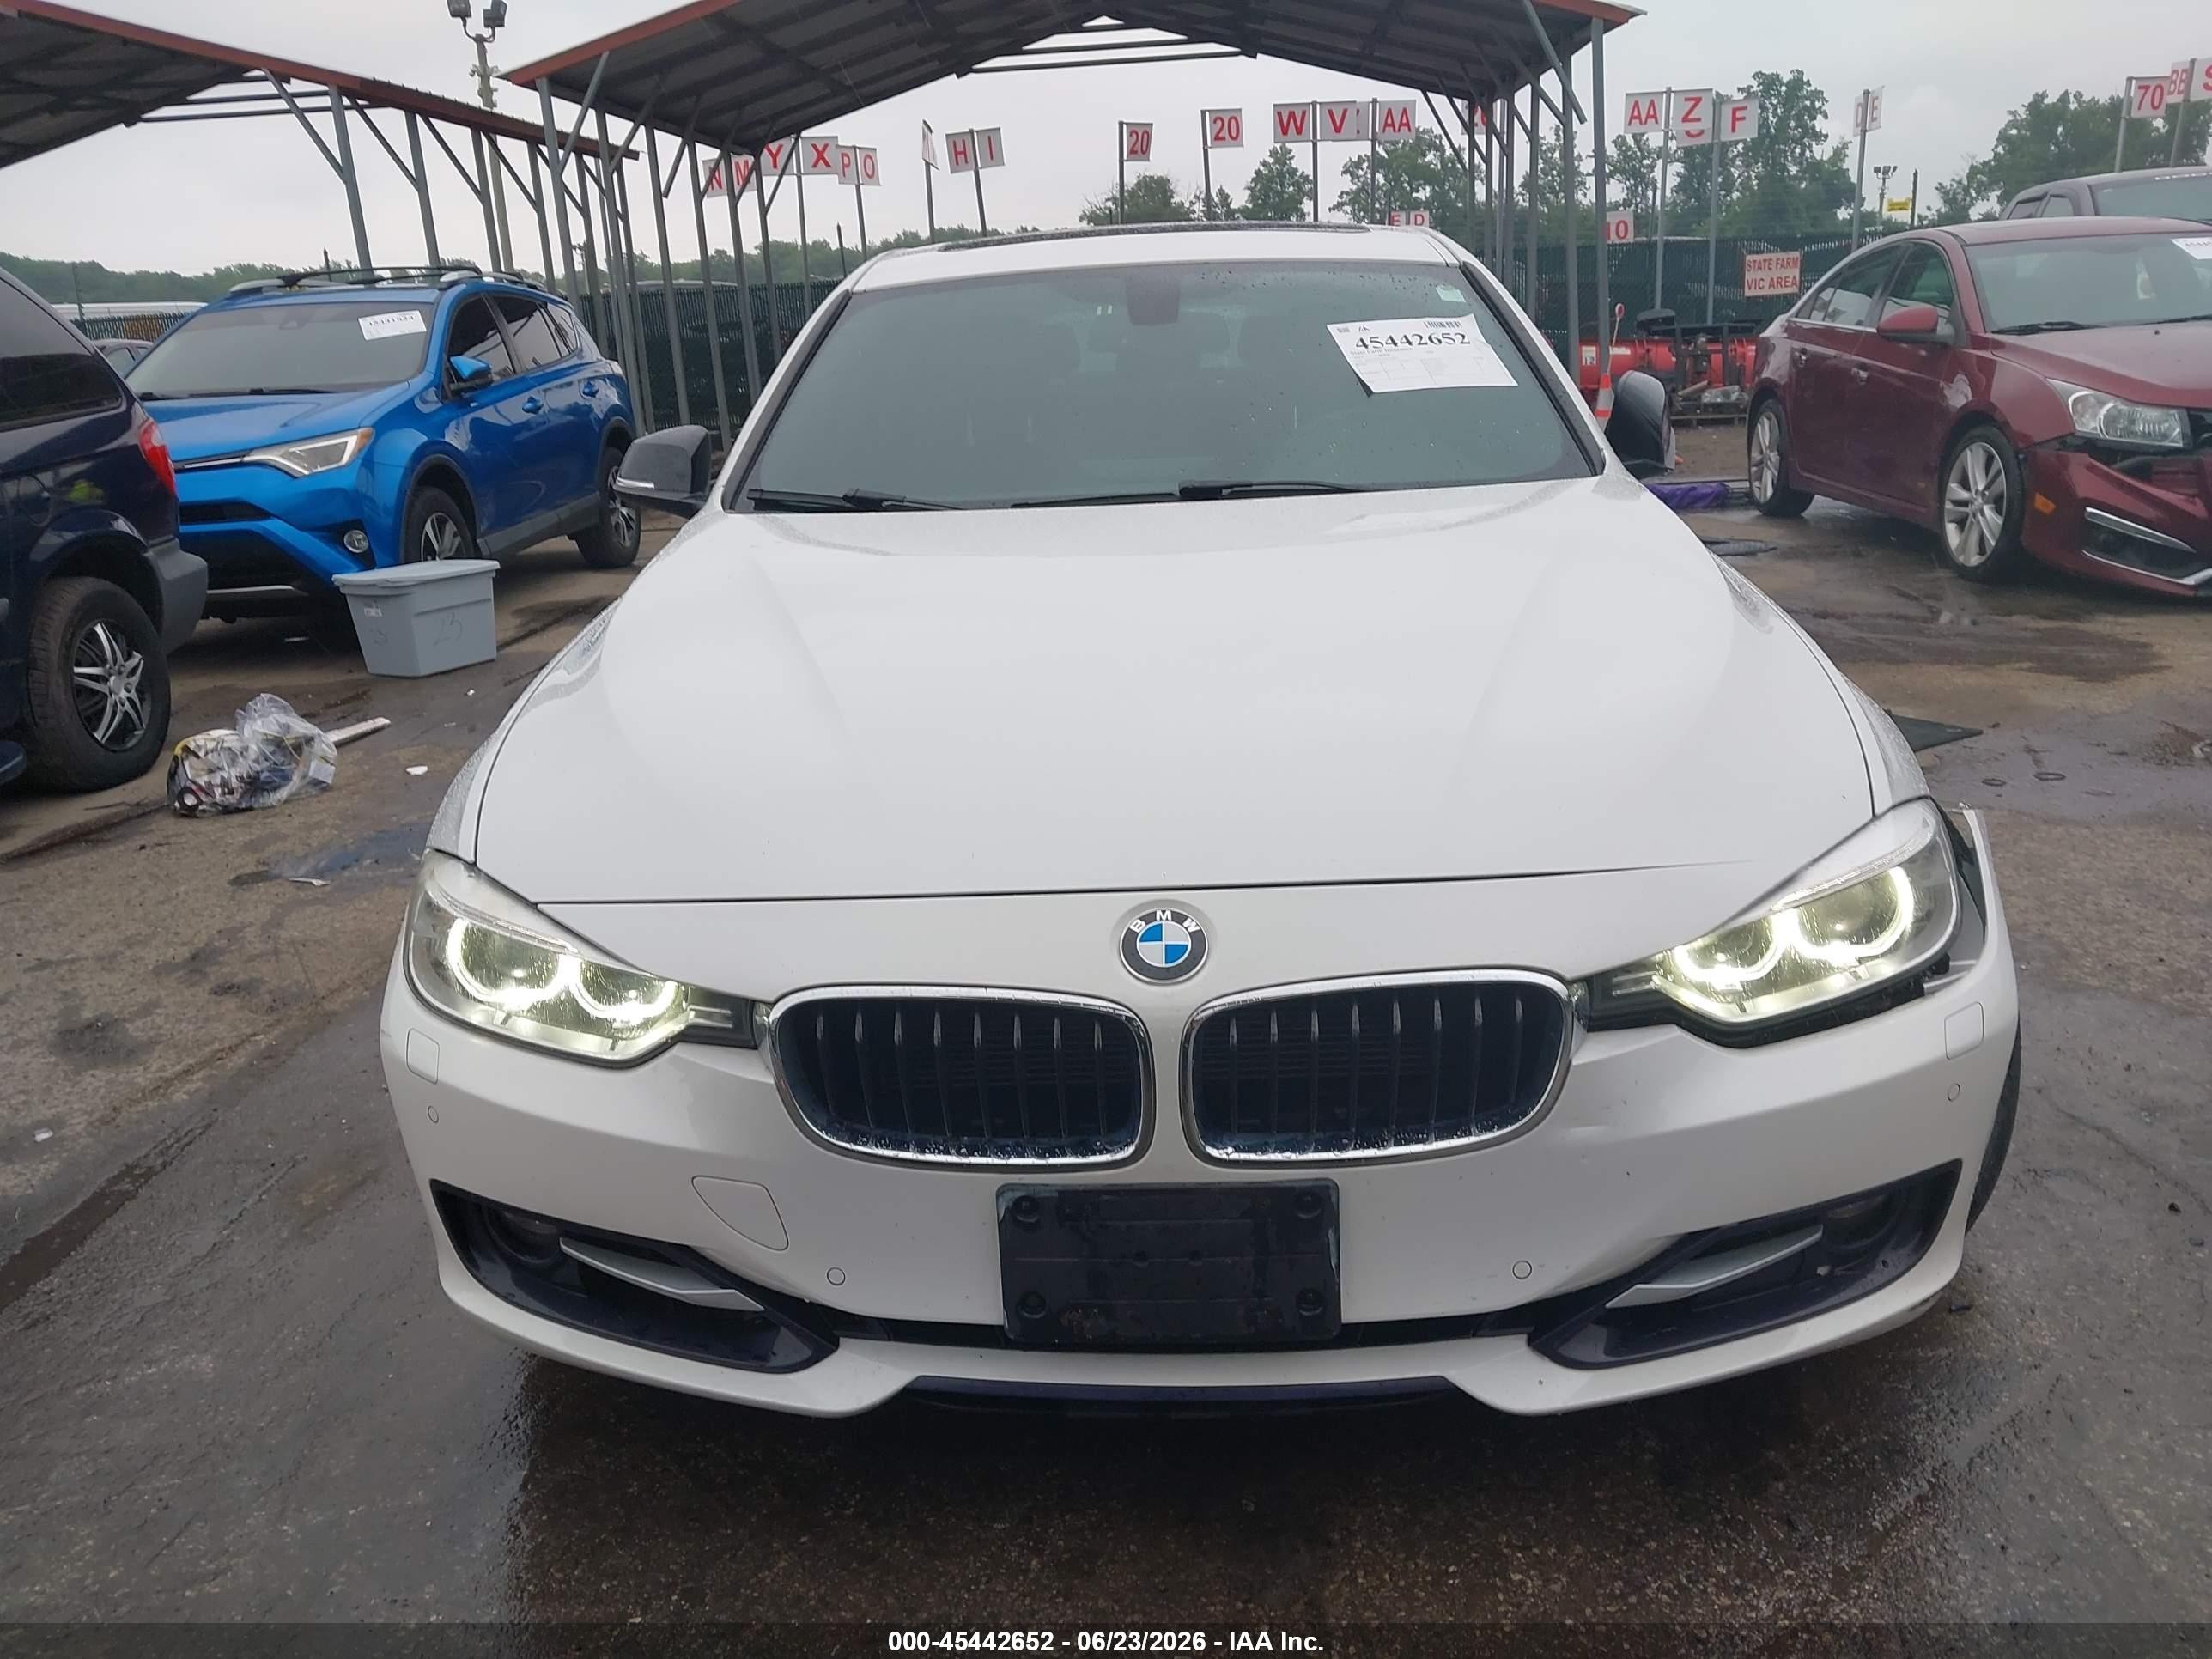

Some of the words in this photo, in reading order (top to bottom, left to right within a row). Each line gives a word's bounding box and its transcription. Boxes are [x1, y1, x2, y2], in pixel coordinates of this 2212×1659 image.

[1681, 96, 1703, 123] Z
[1870, 95, 1879, 122] E
[2137, 83, 2164, 111] 70
[1277, 109, 1307, 136] W
[1328, 108, 1348, 134] V
[1382, 106, 1412, 133] AA
[1628, 99, 1658, 126] AA
[1731, 106, 1748, 133] F
[1129, 129, 1150, 155] 20
[1212, 116, 1240, 142] 20
[764, 143, 783, 169] Y
[811, 143, 832, 168] X
[841, 152, 851, 179] P
[953, 139, 969, 166] H
[708, 166, 723, 191] N
[734, 159, 750, 186] M
[1391, 214, 1401, 227] E
[1414, 214, 1425, 227] D
[1746, 258, 1772, 272] STATE
[1775, 257, 1799, 270] FARM
[1746, 277, 1765, 290] VIC
[1769, 276, 1798, 289] AREA
[1355, 332, 1470, 349] 45442652
[1129, 910, 1200, 933] BMW
